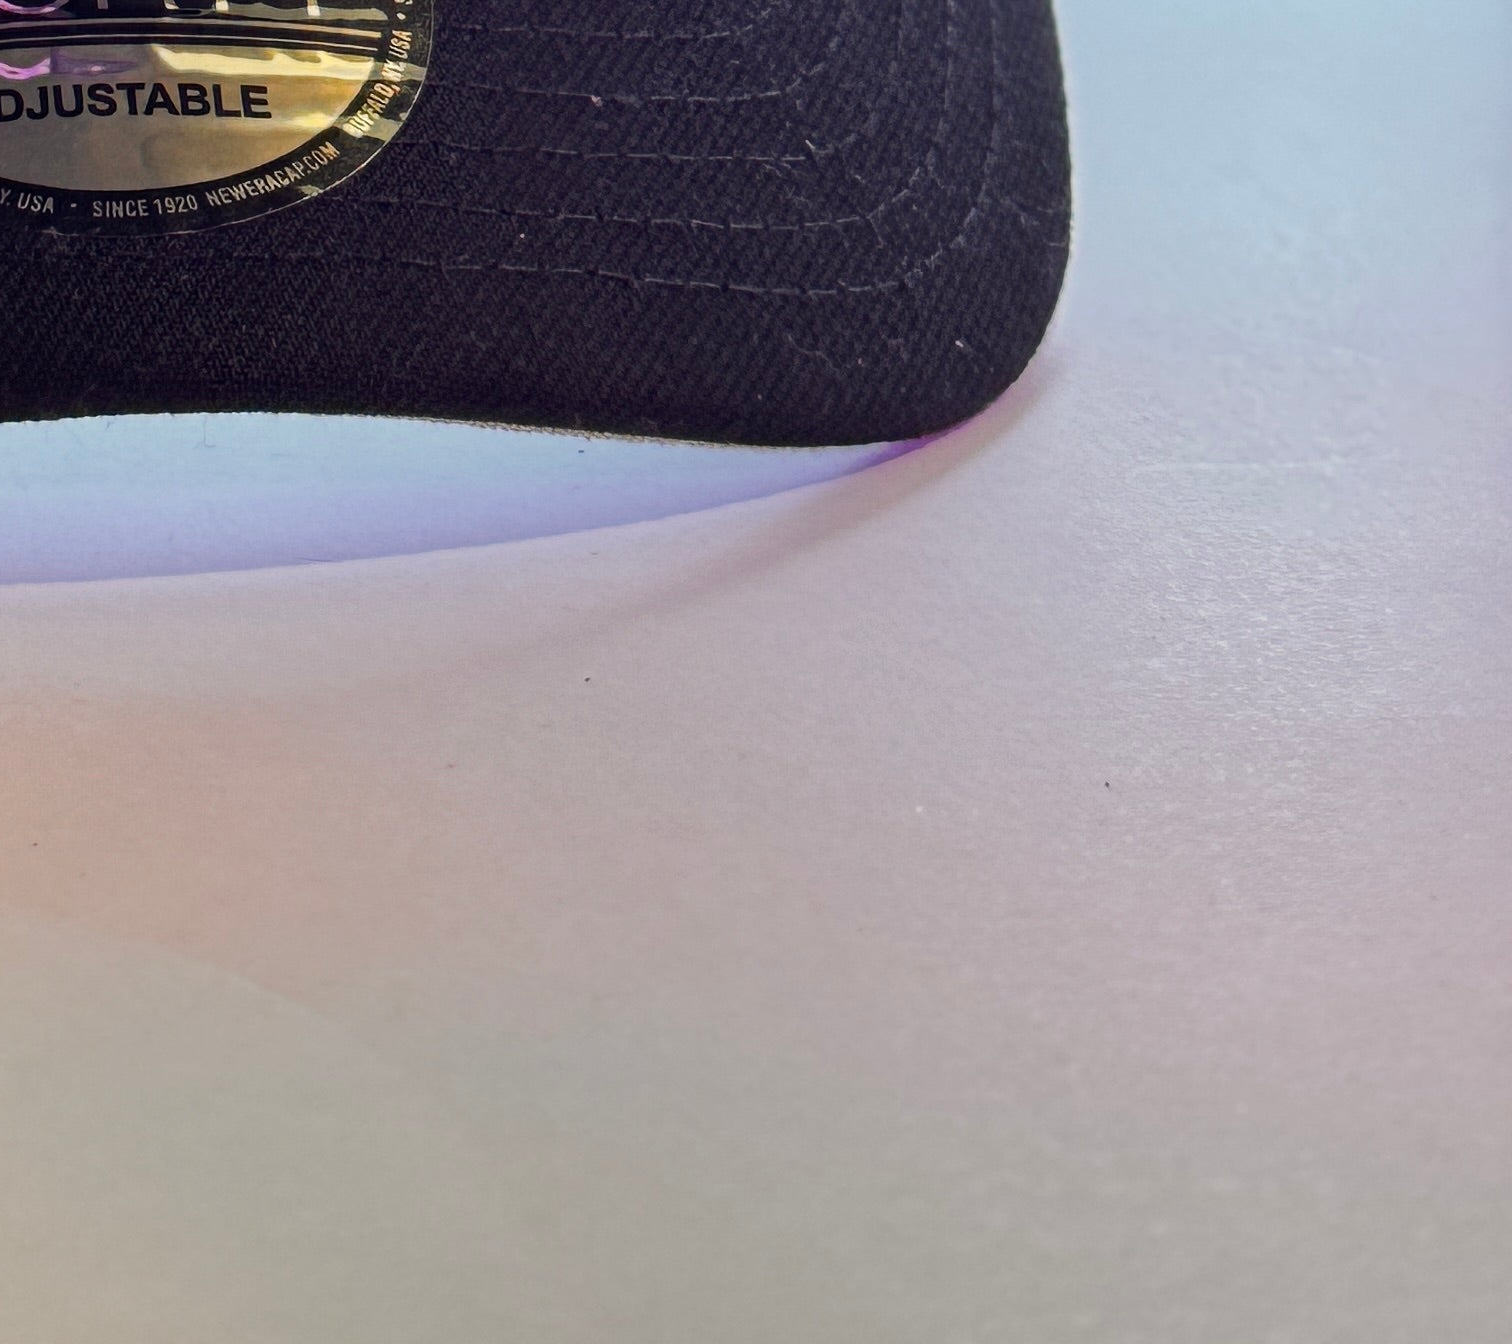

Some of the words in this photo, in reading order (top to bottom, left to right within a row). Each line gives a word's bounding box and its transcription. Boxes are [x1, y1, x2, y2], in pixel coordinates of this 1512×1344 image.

[389, 29, 412, 59] USA
[17, 192, 55, 214] USA
[92, 198, 149, 219] SINCE
[153, 195, 198, 215] 1920
[204, 140, 341, 207] NEWERACAP.COM
